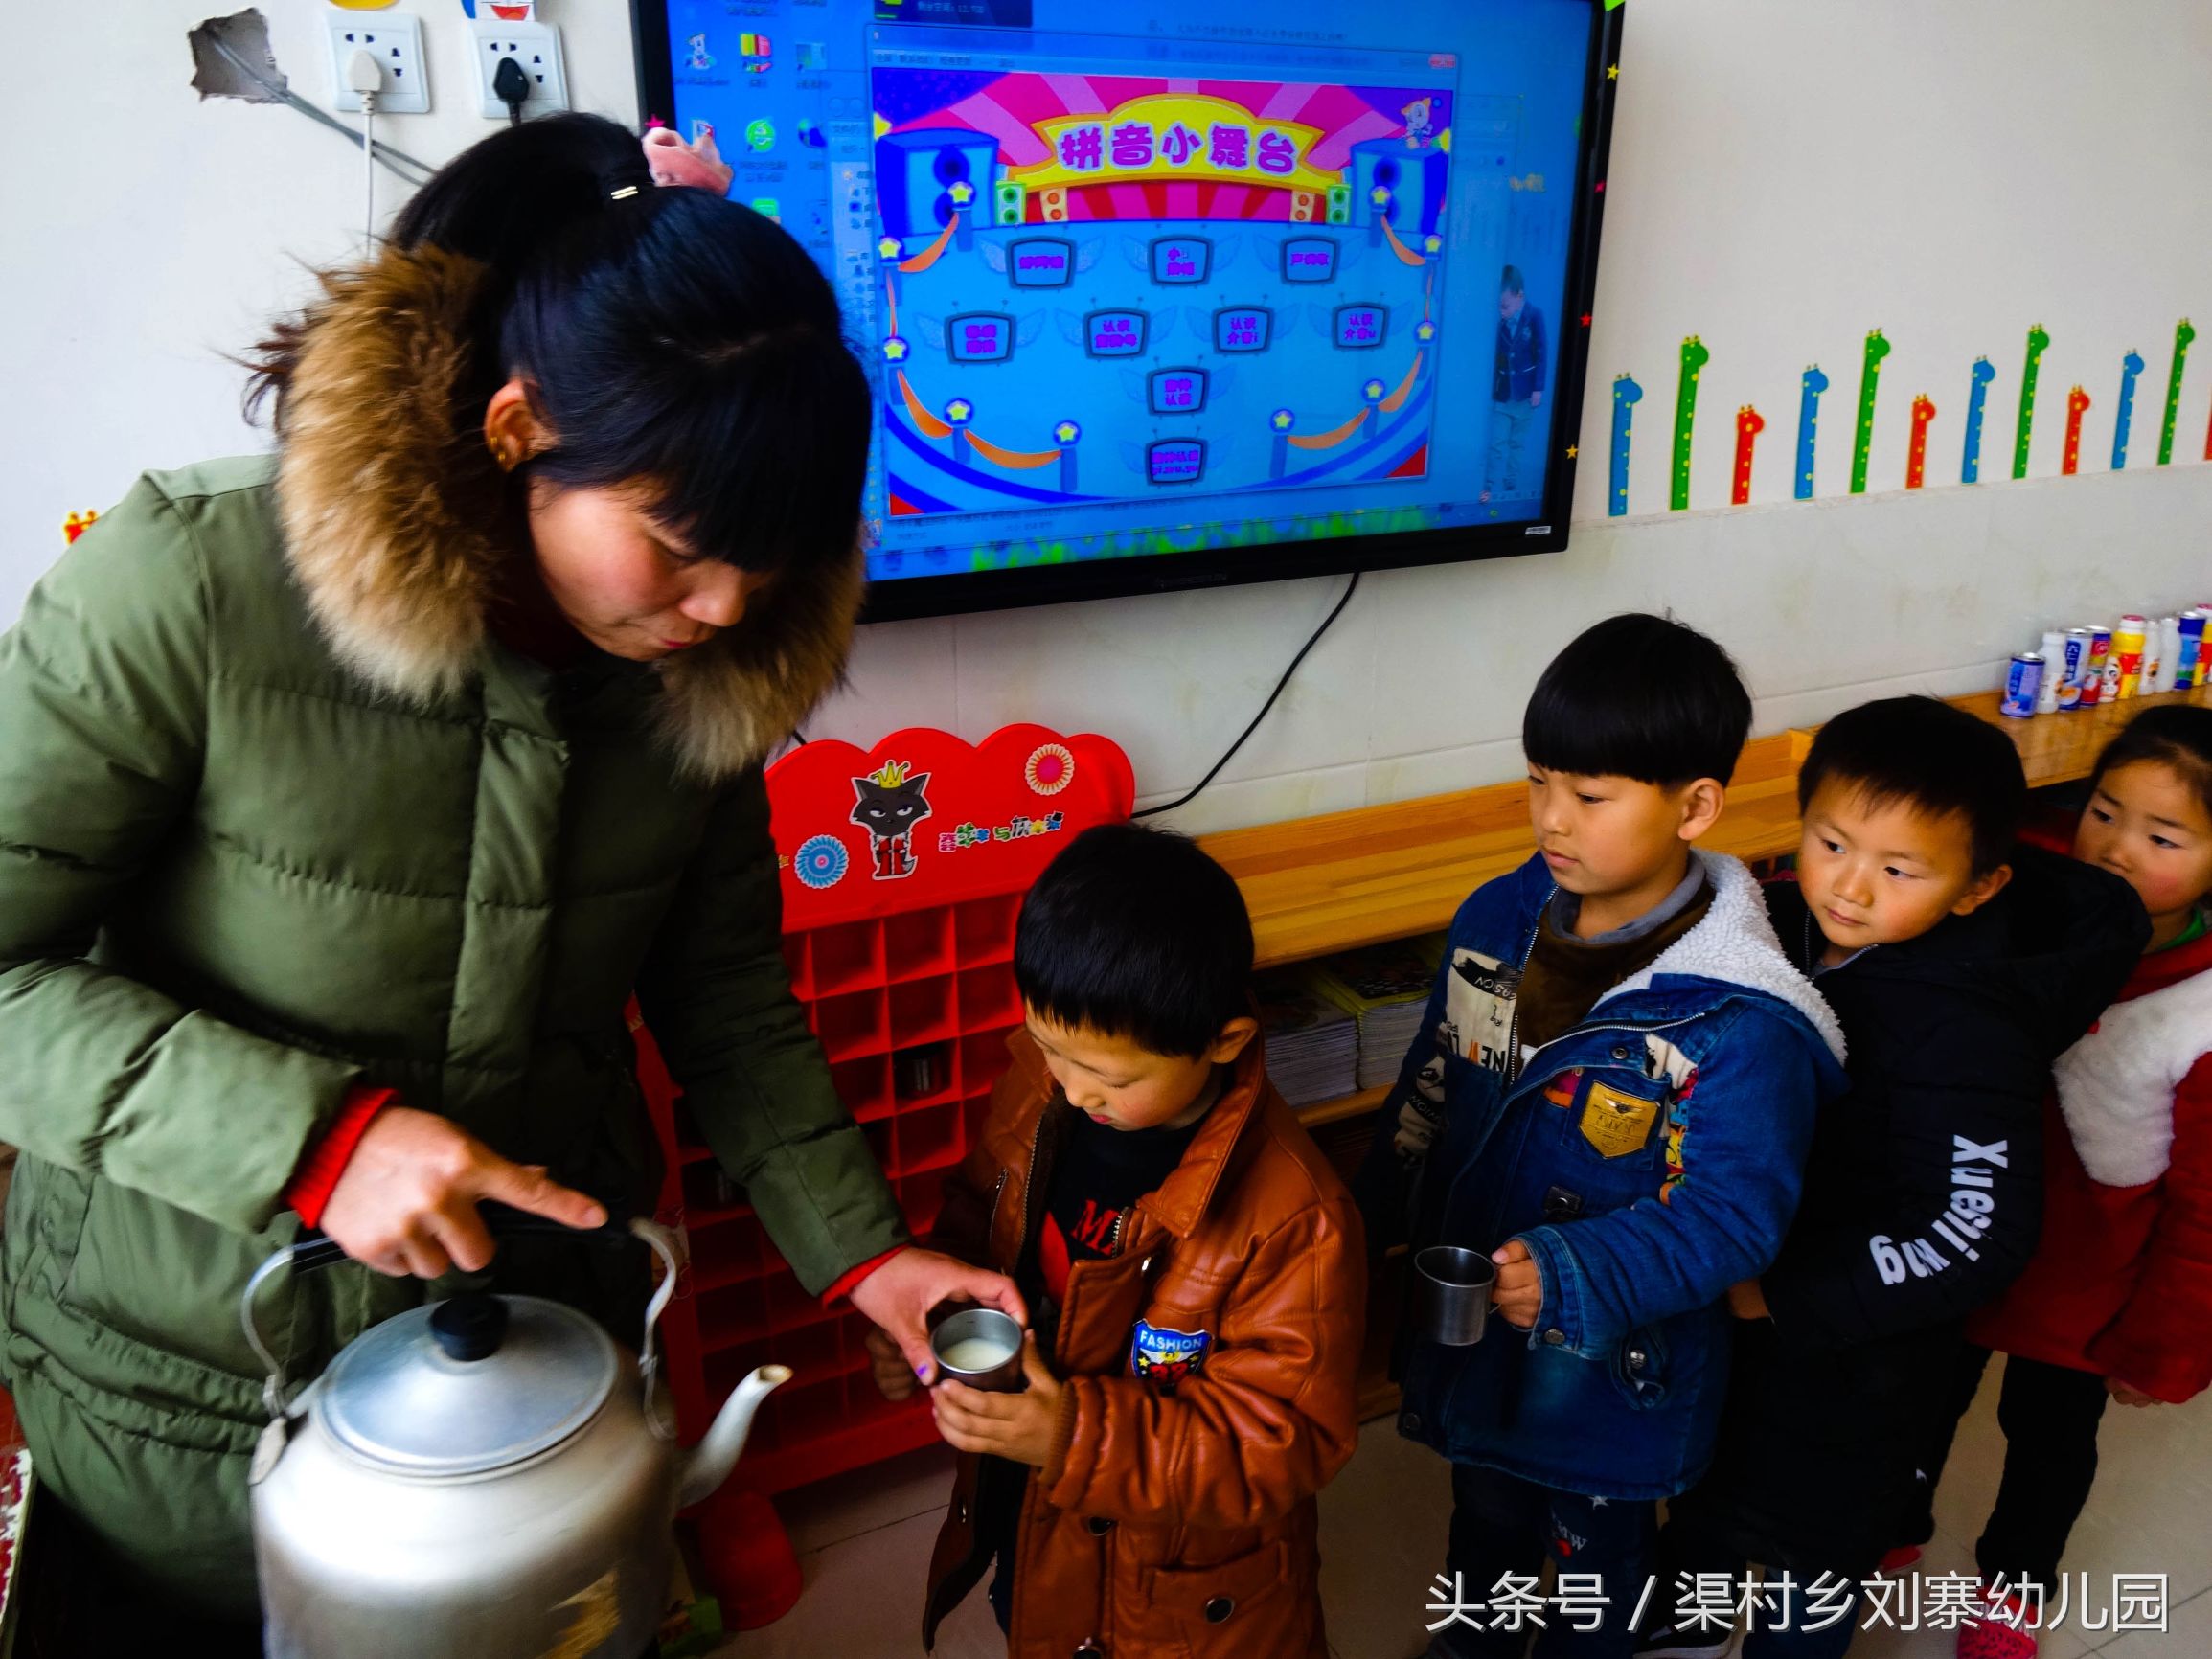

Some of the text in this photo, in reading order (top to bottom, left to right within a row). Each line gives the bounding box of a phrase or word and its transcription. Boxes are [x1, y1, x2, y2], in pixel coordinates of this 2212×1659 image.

[1059, 123, 1296, 175] 拼音小舞台
[1139, 1329, 1203, 1351] FASHION
